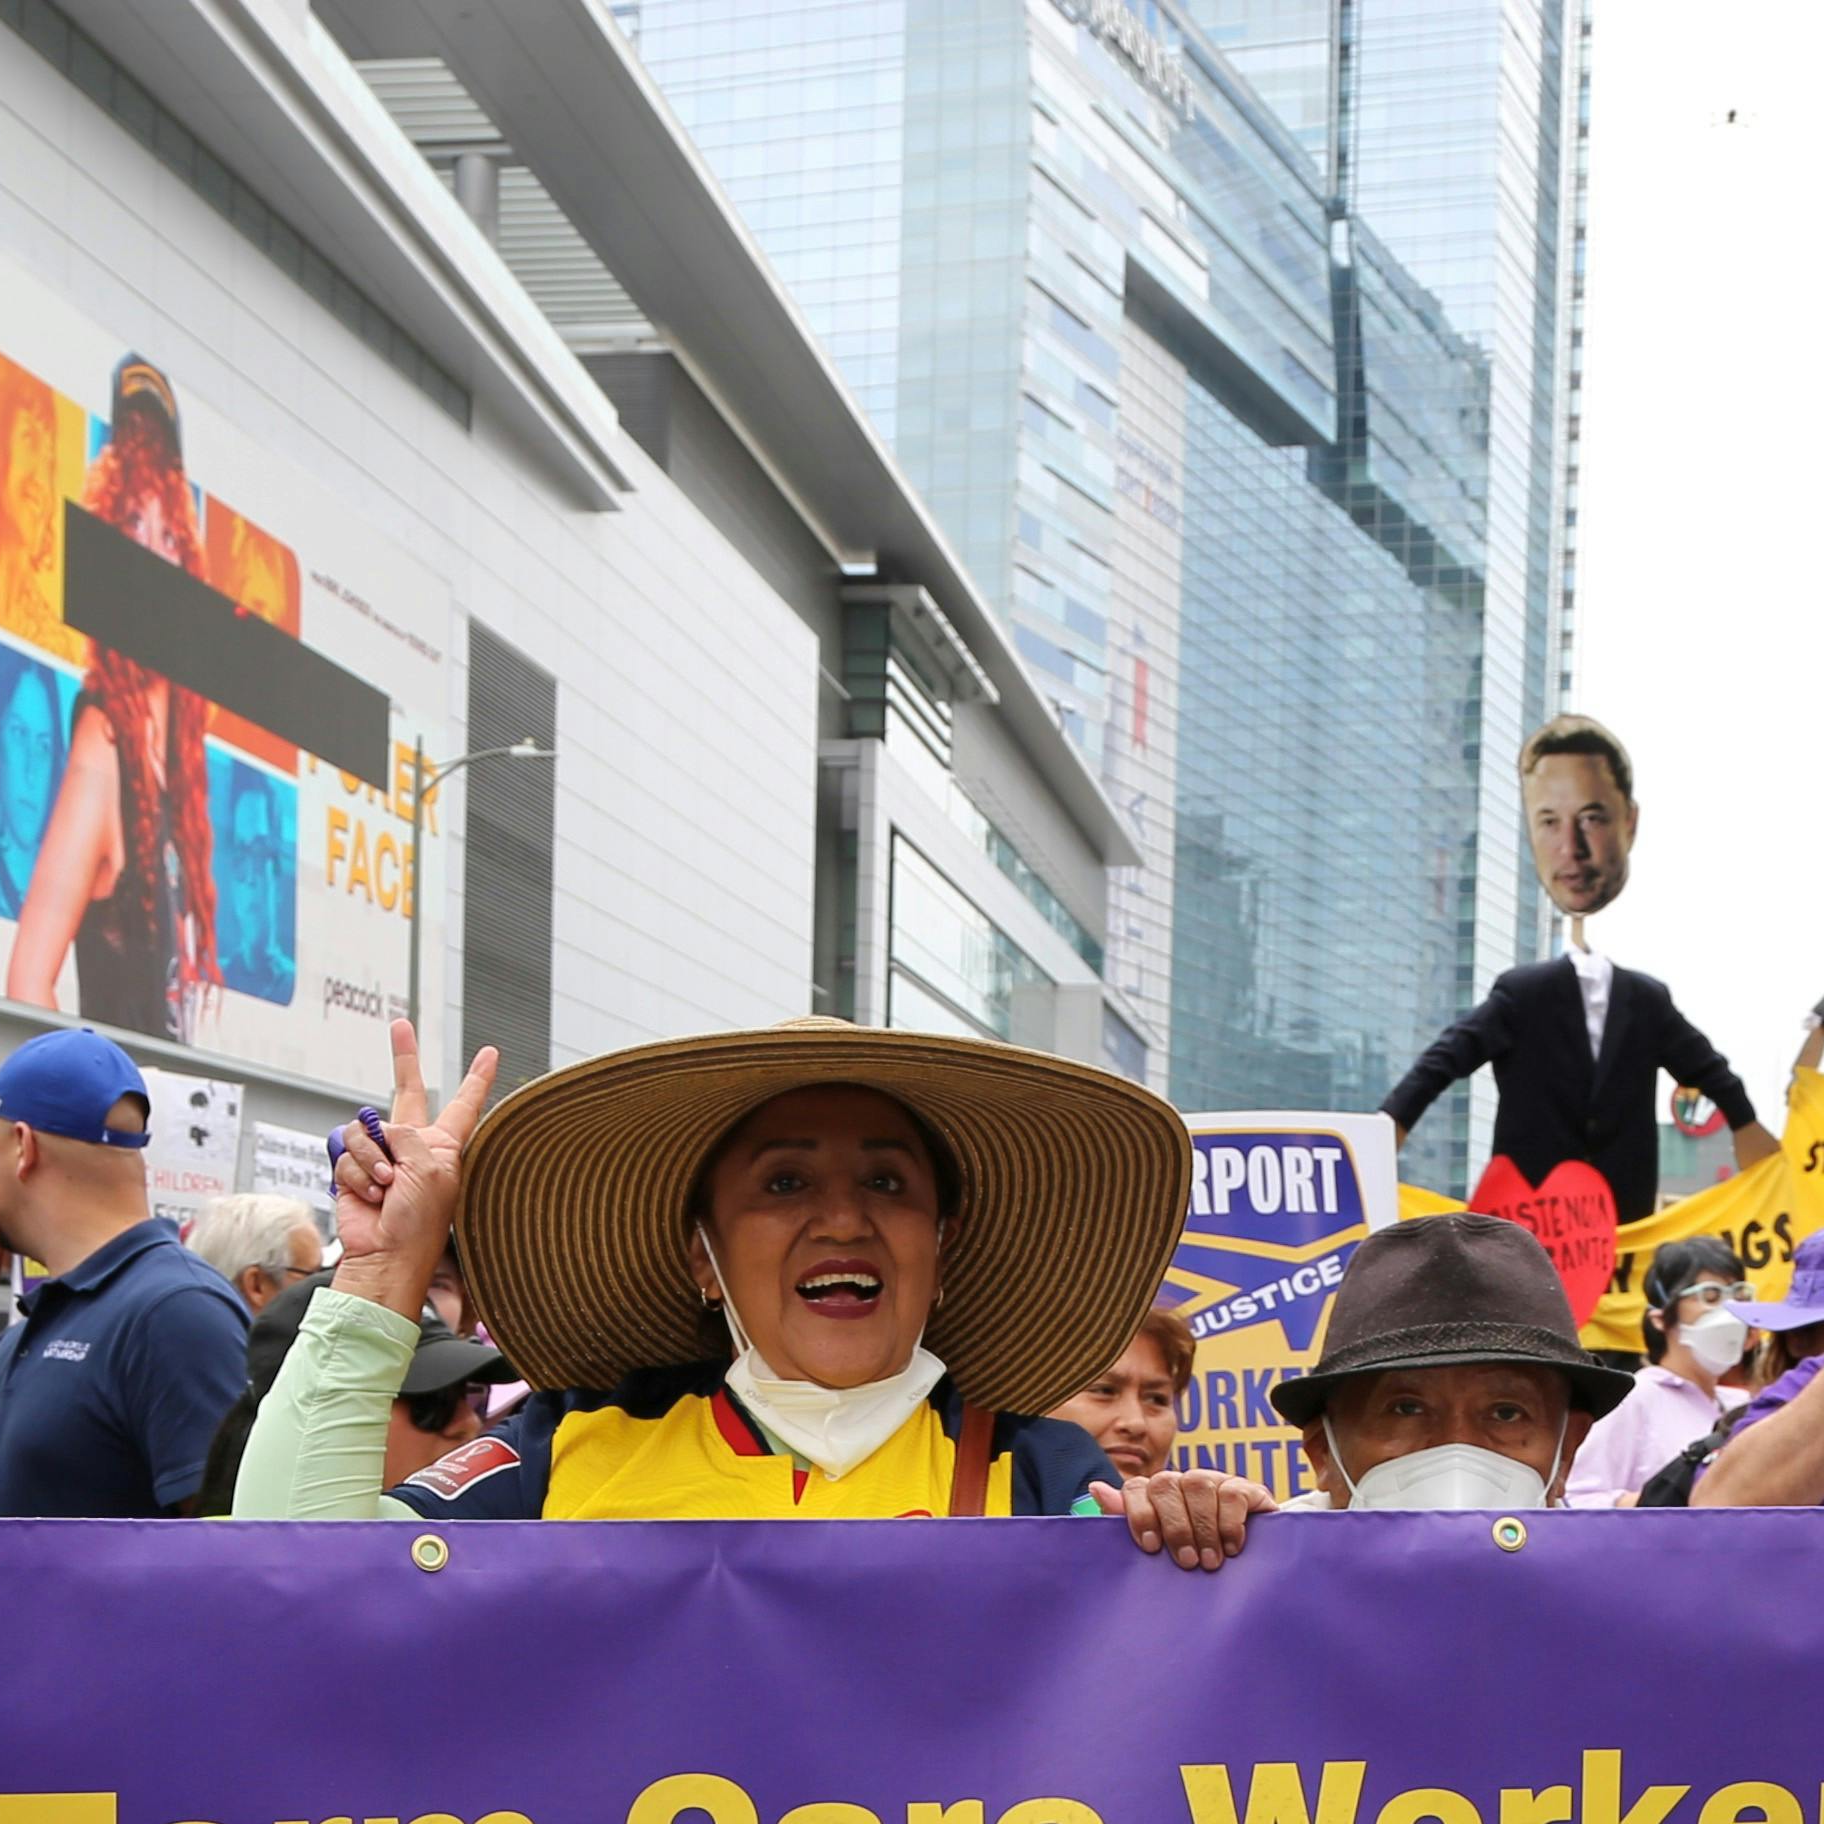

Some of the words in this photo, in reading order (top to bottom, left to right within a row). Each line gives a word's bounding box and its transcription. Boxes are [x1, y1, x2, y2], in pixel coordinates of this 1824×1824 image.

[327, 806, 415, 920] FACE
[324, 976, 384, 1021] peacock
[145, 1165, 225, 1193] HILDREN
[1188, 1146, 1341, 1216] RPORT
[1189, 1254, 1344, 1340] JUSTICE
